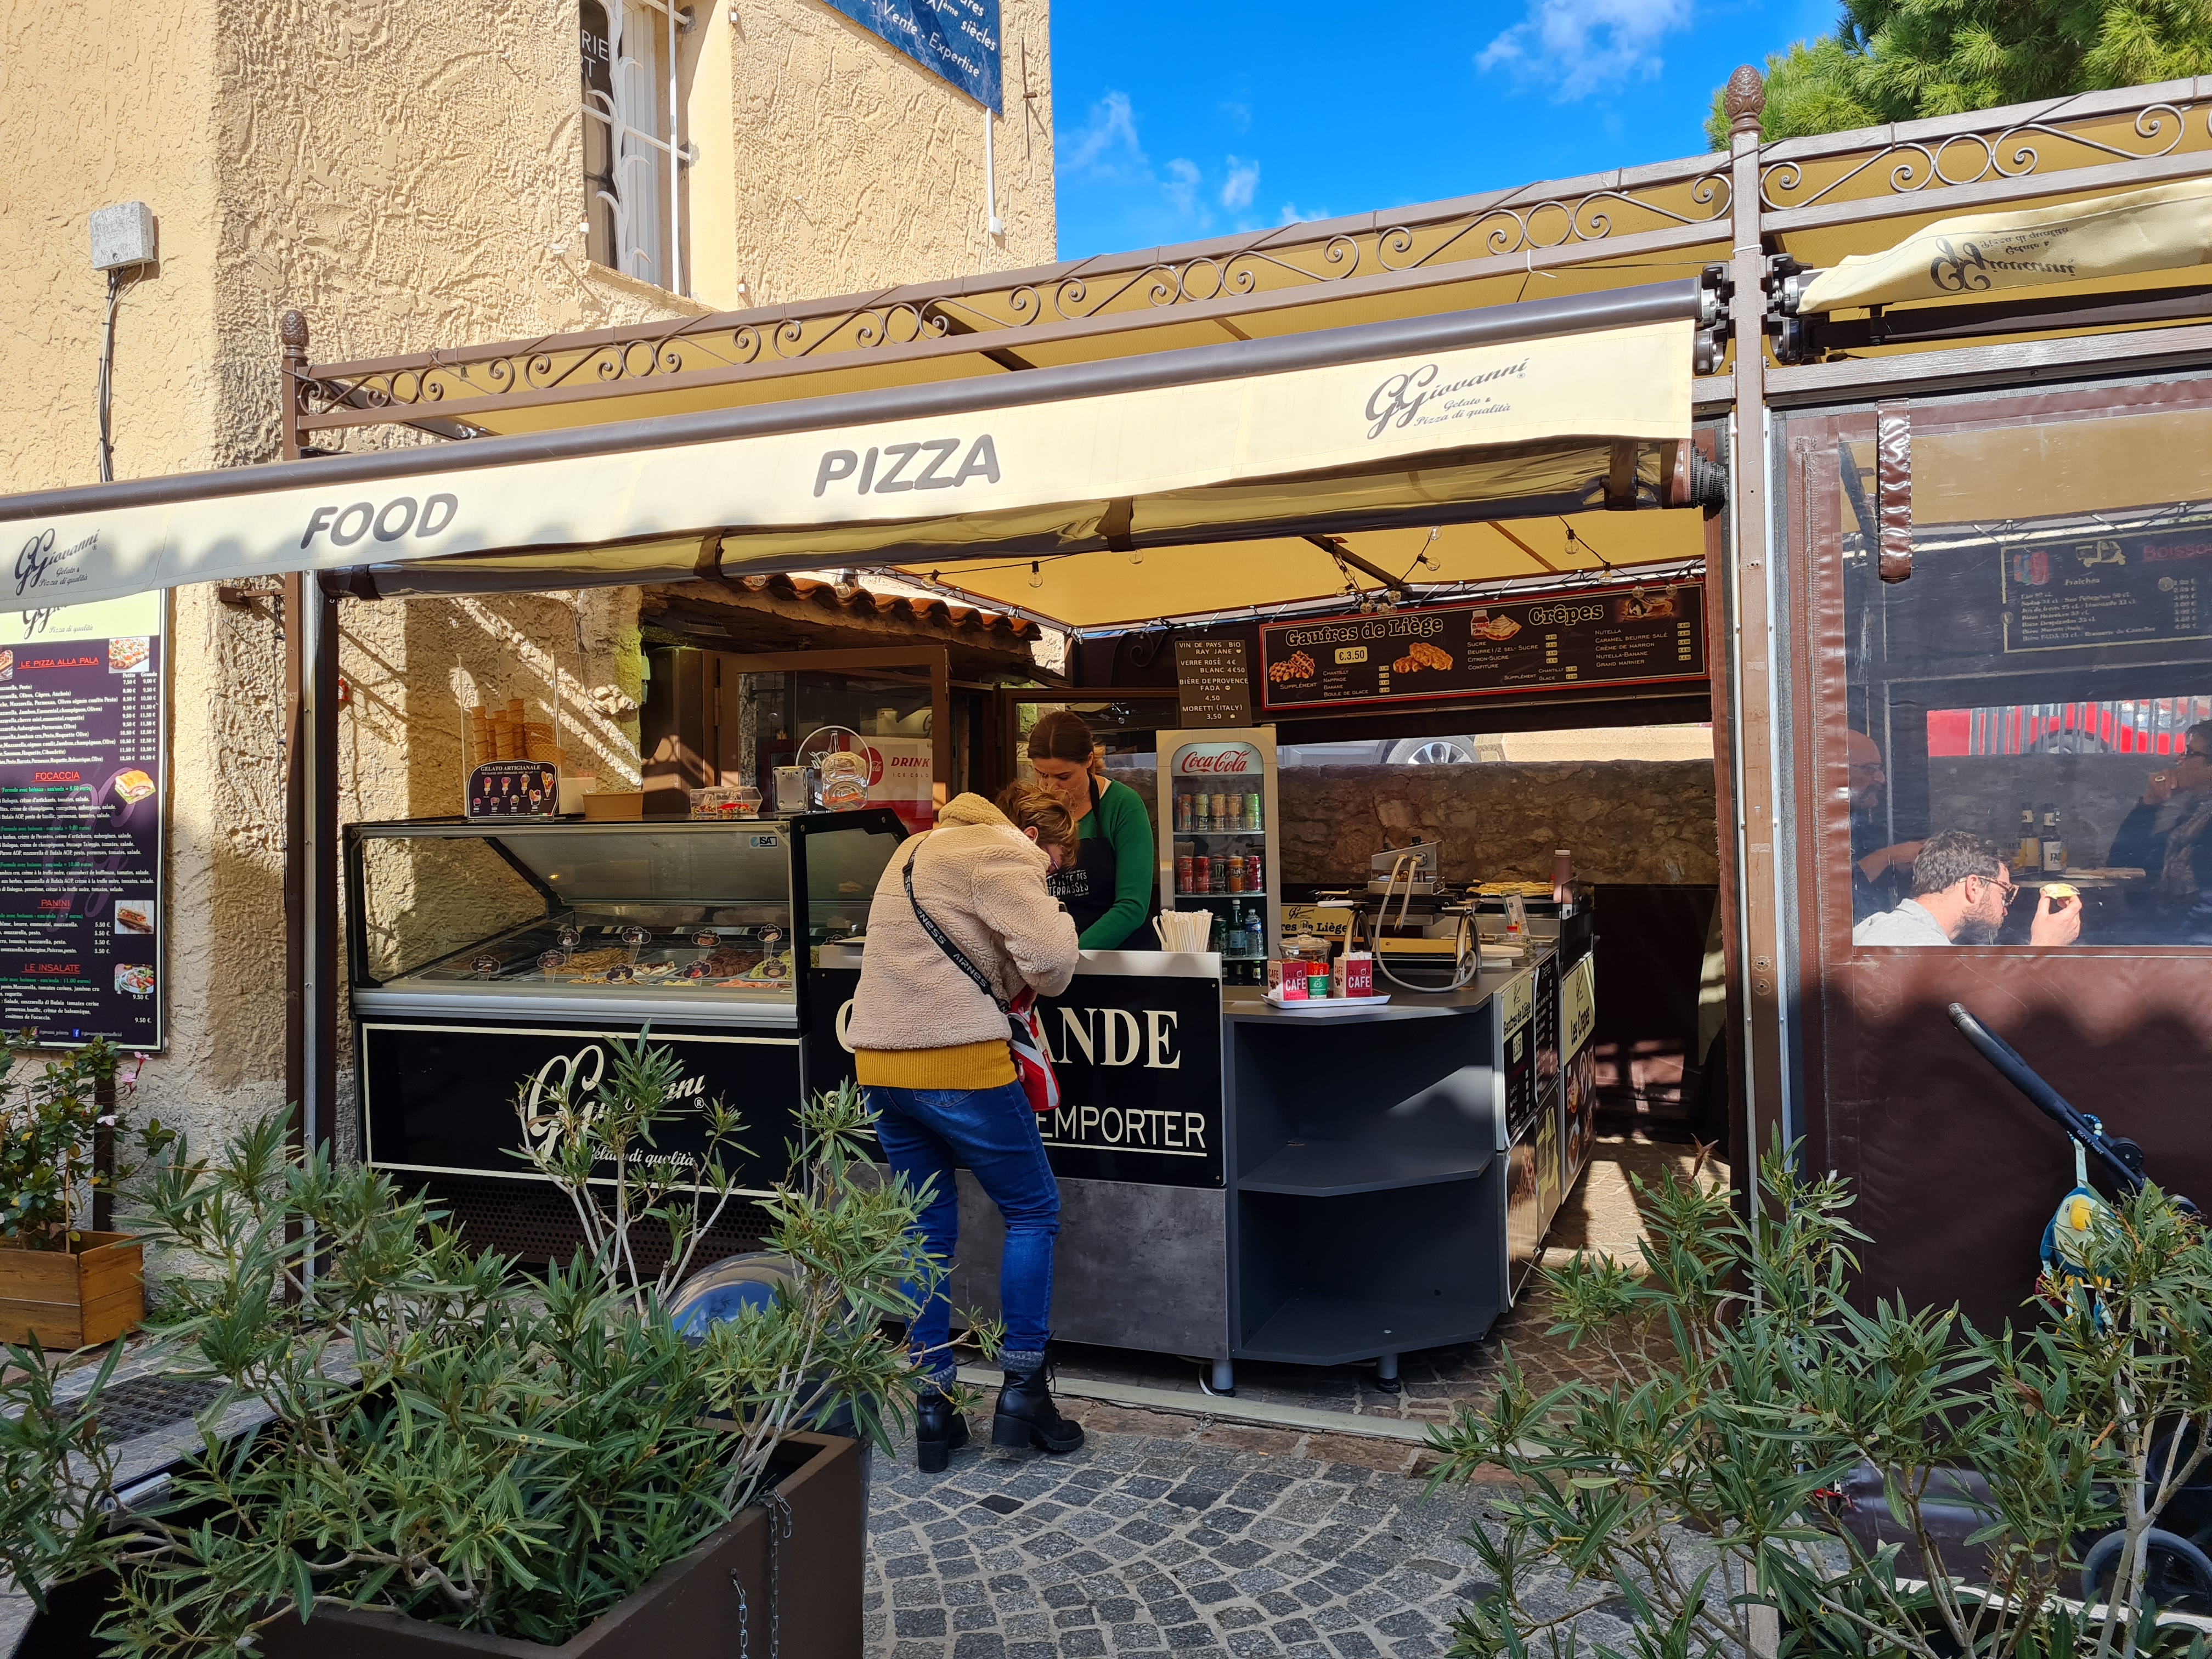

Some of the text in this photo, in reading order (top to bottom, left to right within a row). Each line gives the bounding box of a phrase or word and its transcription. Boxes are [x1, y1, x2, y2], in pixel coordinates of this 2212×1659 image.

[884, 0, 918, 35] Vente
[928, 31, 980, 77] Expertise
[961, 20, 996, 51] siècles
[1443, 397, 1481, 411] Gelato
[1413, 404, 1511, 426] Pizza di qualità
[814, 434, 1000, 498] PIZZA
[300, 493, 459, 550] FOOD
[56, 567, 75, 577] Gelato
[38, 573, 88, 587] Pizza di qualità
[1528, 604, 1604, 625] Crêpes
[74, 624, 93, 634] qualità
[1285, 617, 1443, 646] Gaufres de Liège
[1204, 657, 1221, 665] ROSÉ
[1339, 650, 1365, 661] €.3.50
[1596, 651, 1649, 659] NUTELLA-BANANE
[1180, 676, 1200, 685] BIÈRE
[890, 757, 931, 768] DRINK
[1181, 750, 1251, 773] Coca-Cola
[35, 771, 80, 780] FOCACCIA
[759, 837, 773, 845] ISA
[1076, 872, 1087, 881] DES
[1048, 882, 1088, 897] TERRASSES
[38, 964, 80, 973] INSALATE
[1268, 969, 1279, 979] CAFE
[1334, 965, 1343, 976] CAFE
[1285, 978, 1306, 991] CAFE
[1348, 977, 1370, 988] CAFE
[1036, 1105, 1206, 1148] EMPORTER
[629, 1148, 642, 1163] di
[645, 1151, 695, 1168] qualità
